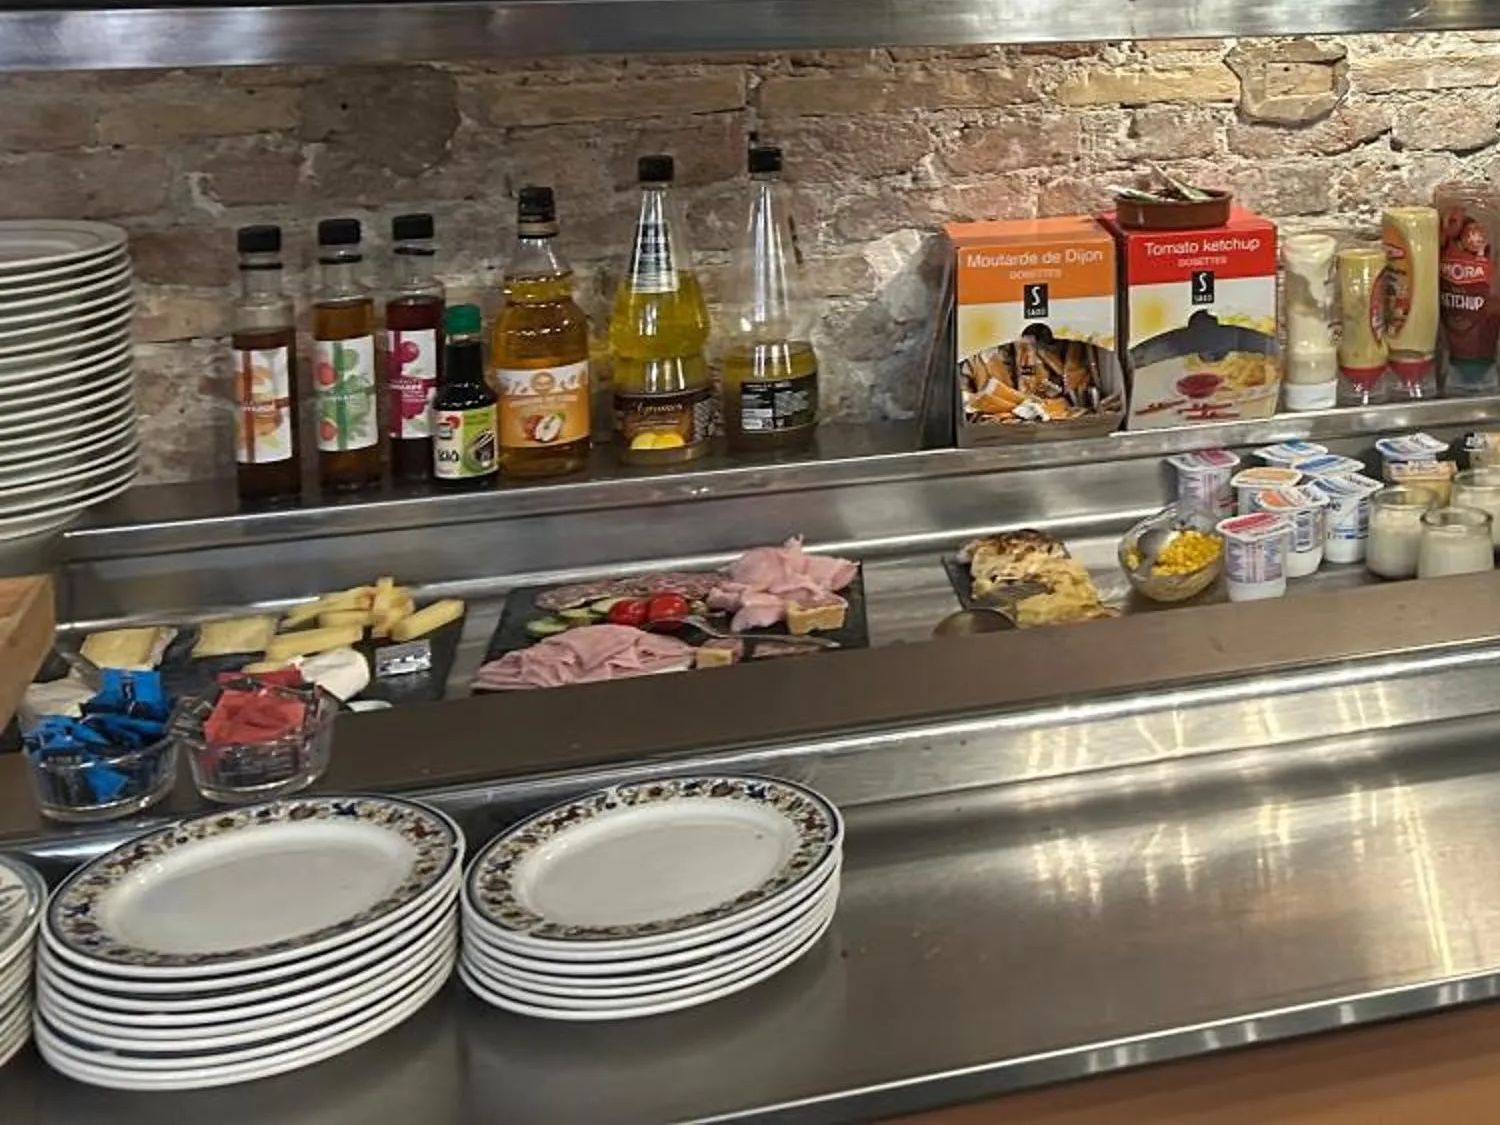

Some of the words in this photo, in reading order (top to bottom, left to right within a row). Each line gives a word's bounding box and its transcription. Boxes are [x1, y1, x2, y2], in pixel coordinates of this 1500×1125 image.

[1143, 241, 1199, 257] Tomato
[1202, 237, 1261, 252] ketchup
[966, 252, 1039, 268] Moutarde
[1040, 252, 1062, 265] de
[1064, 248, 1104, 266] Dijon
